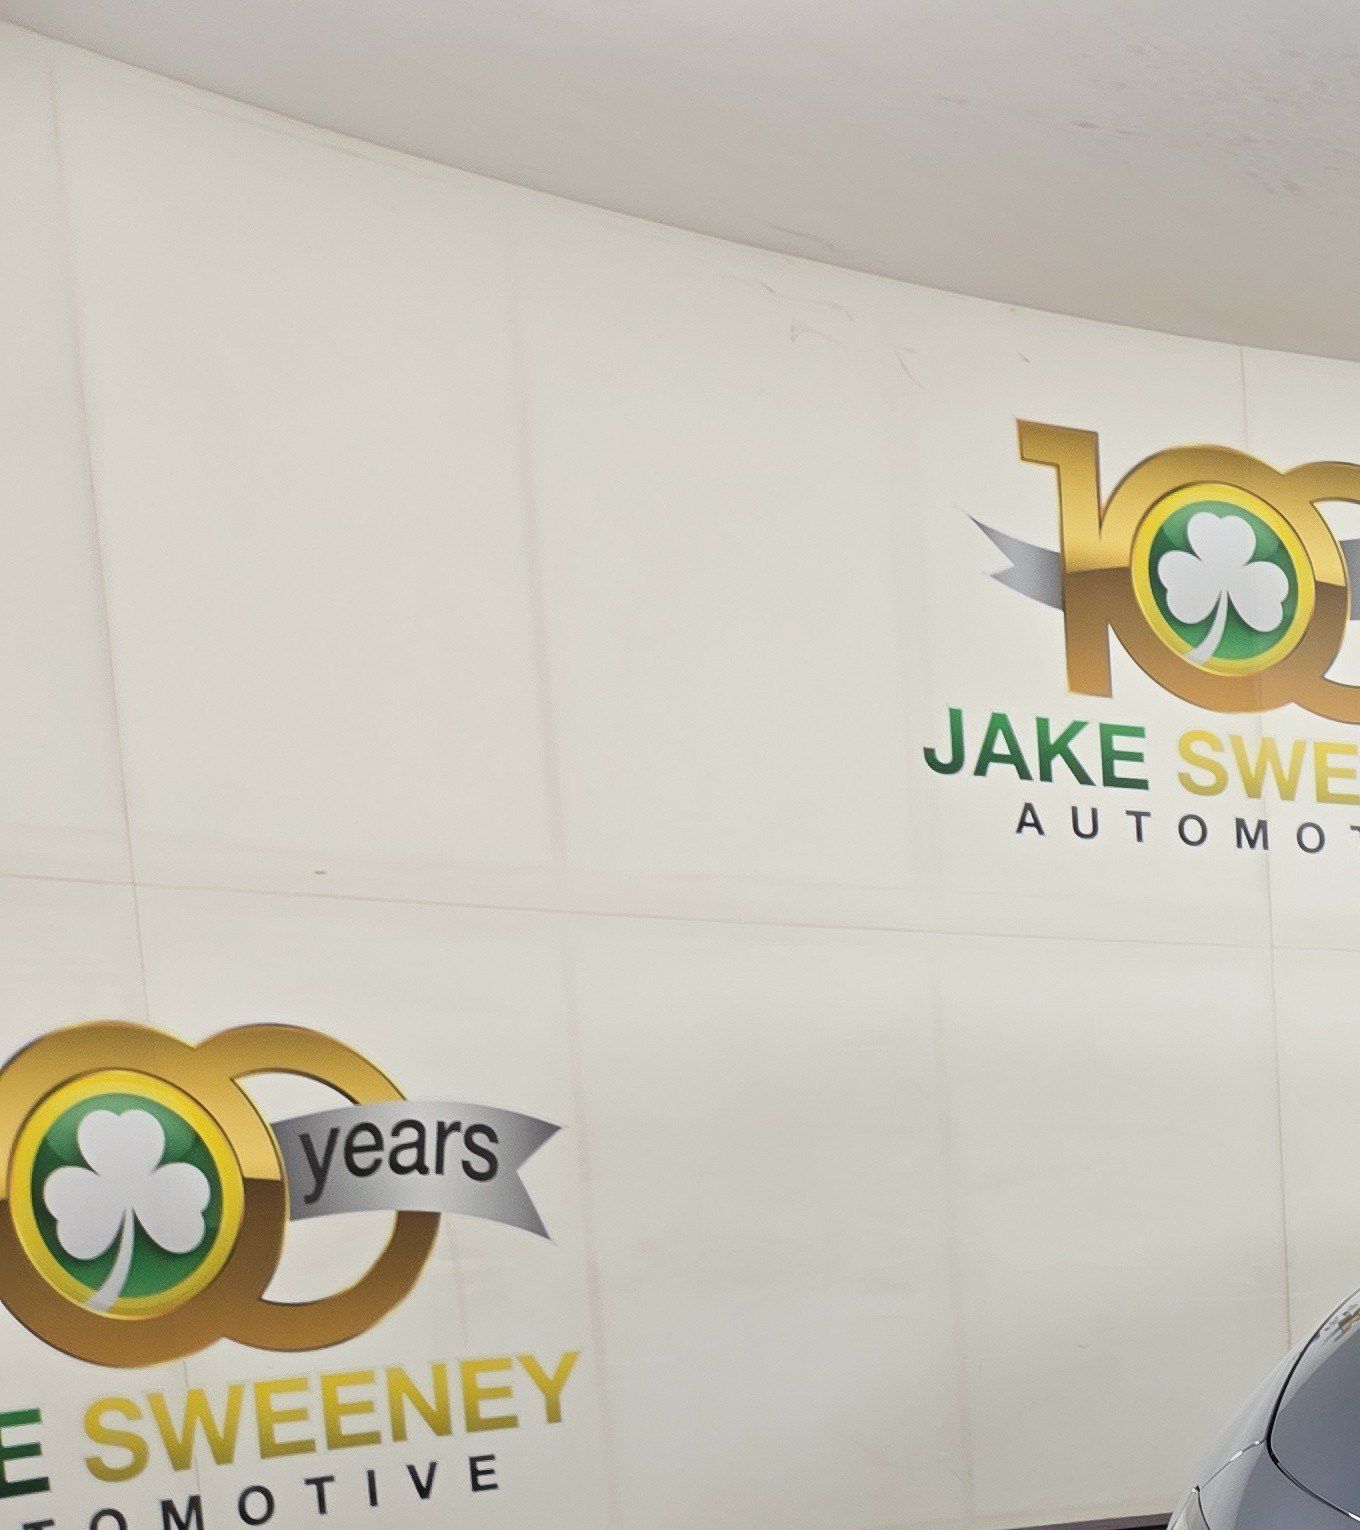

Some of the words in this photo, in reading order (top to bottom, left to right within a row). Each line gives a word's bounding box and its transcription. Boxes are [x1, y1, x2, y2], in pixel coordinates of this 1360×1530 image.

[922, 707, 1150, 791] JAKE
[299, 1117, 500, 1204] years
[82, 1351, 580, 1483] SWEENEY
